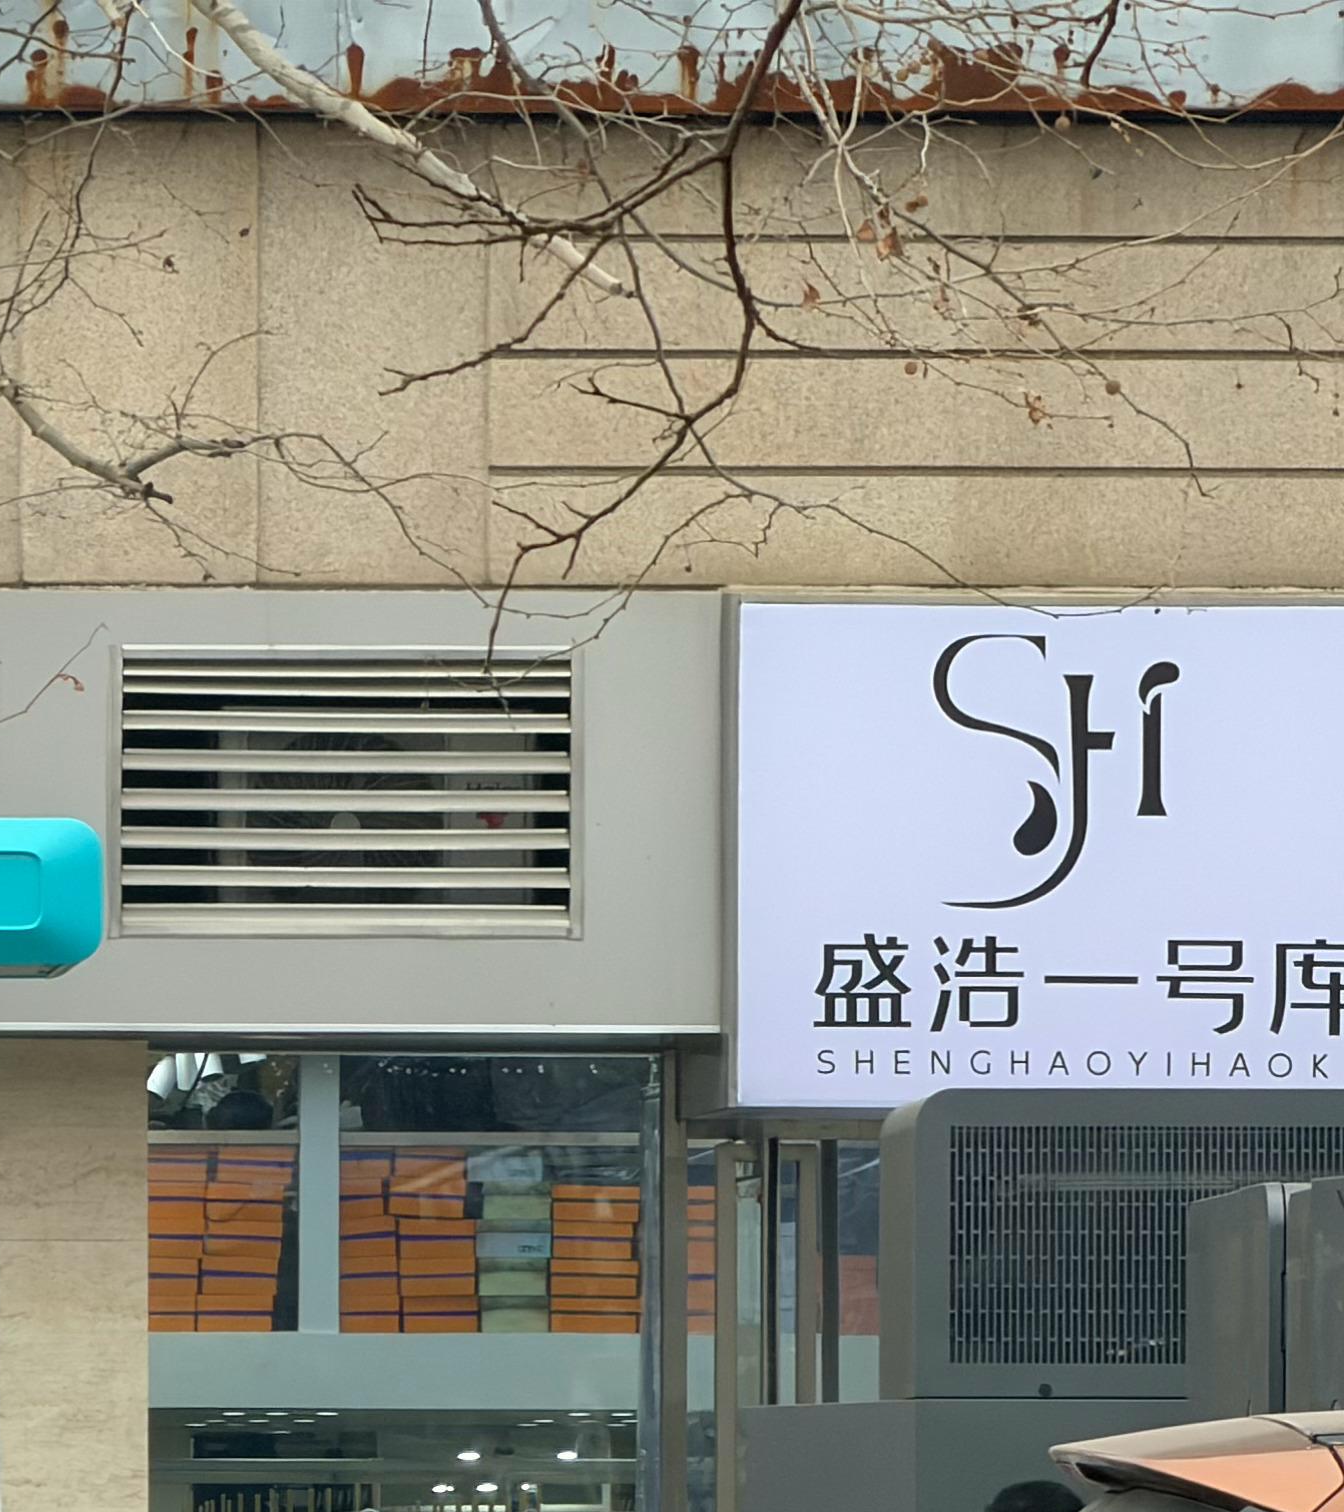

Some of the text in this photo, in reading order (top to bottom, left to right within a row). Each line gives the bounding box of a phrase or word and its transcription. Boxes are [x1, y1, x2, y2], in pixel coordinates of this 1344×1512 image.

[813, 932, 1344, 1036] 盛浩一号库
